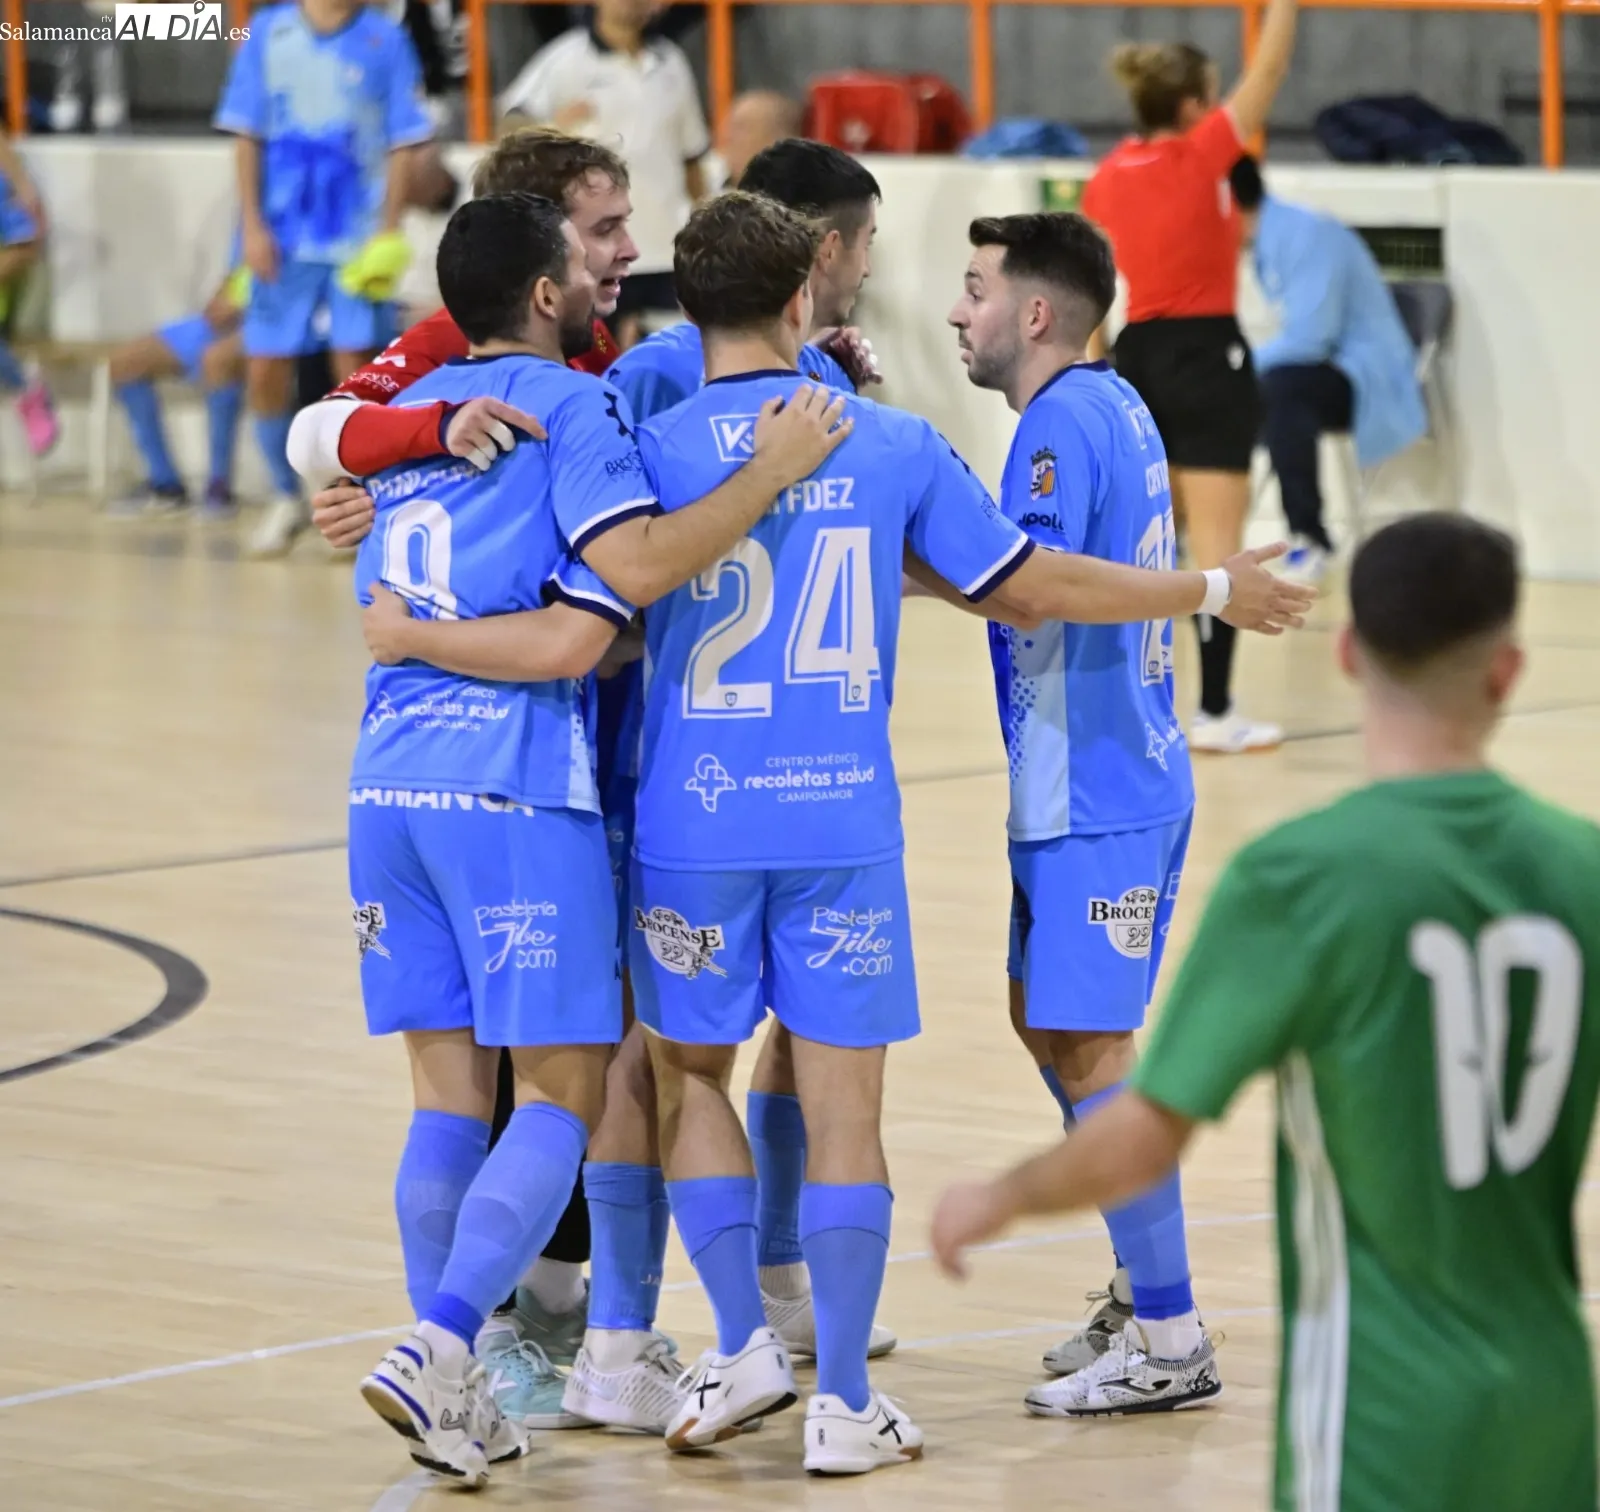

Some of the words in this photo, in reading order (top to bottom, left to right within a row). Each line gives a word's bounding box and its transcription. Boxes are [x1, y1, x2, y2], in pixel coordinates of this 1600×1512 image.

[787, 476, 855, 514] FDEZ
[682, 527, 881, 719] 24
[765, 756, 814, 769] CENTRO
[744, 768, 832, 791] recoletas
[836, 765, 875, 786] salud
[777, 788, 854, 804] CAMPOAMOR
[660, 940, 686, 967] 22
[841, 954, 894, 977] .com
[1406, 911, 1585, 1191] 10
